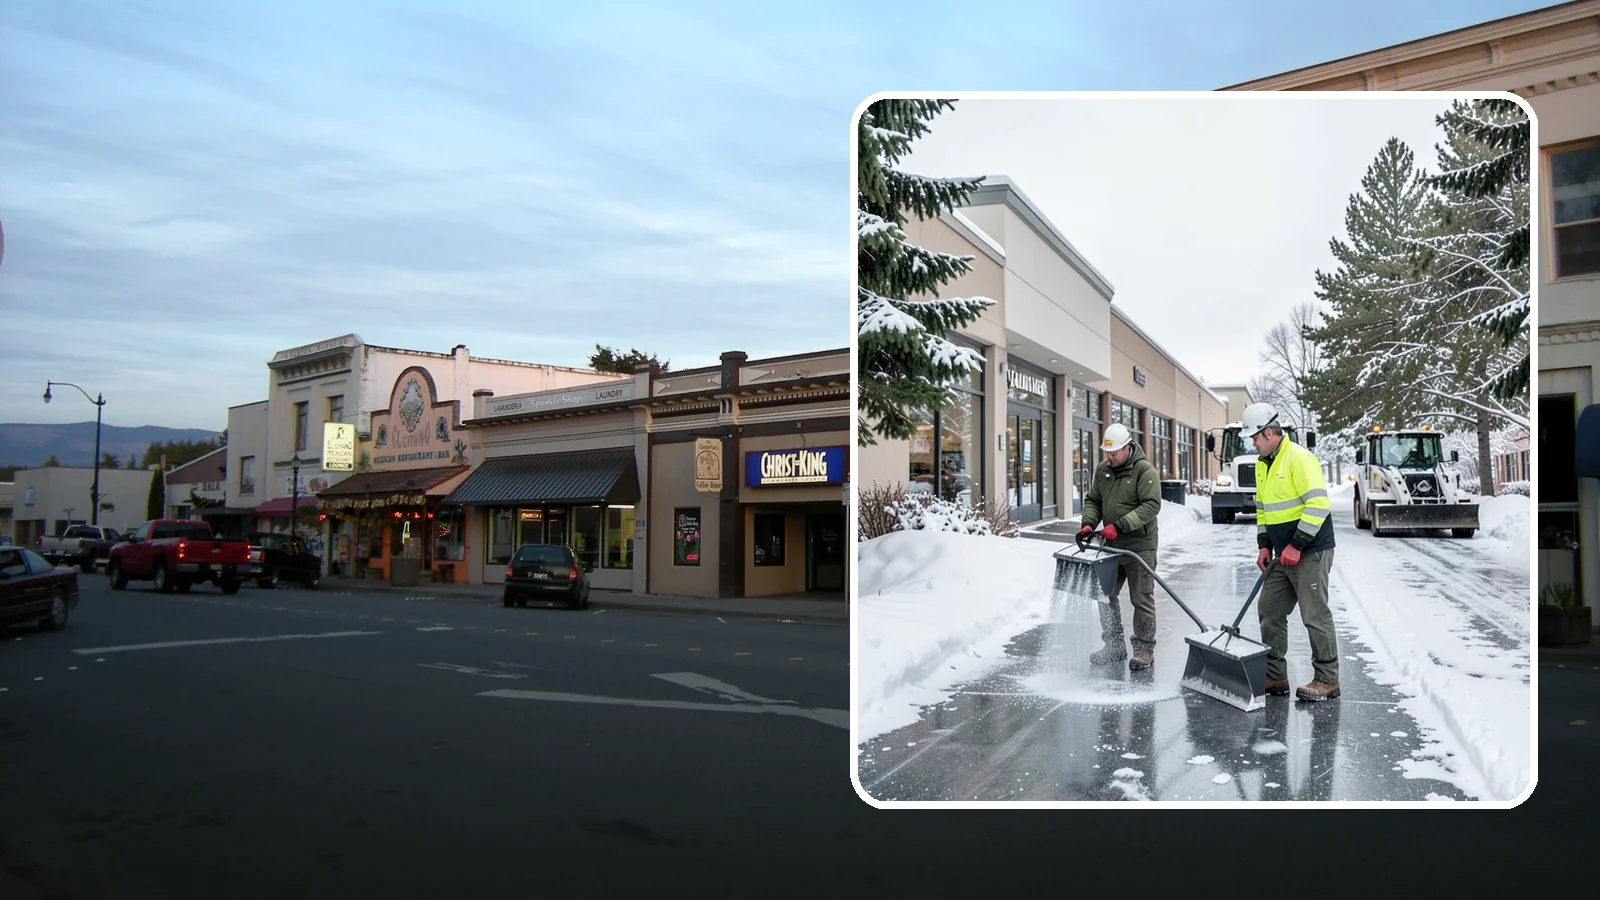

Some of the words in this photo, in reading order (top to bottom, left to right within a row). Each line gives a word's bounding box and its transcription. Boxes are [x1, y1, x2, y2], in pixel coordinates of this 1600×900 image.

[562, 395, 582, 405] Shop
[595, 389, 623, 400] LAUNDRY
[494, 402, 522, 412] LAVANDERIA
[398, 452, 433, 462] RESTAURANT
[438, 450, 450, 459] BAR
[761, 452, 797, 478] CHRIST
[799, 450, 827, 476] KING
